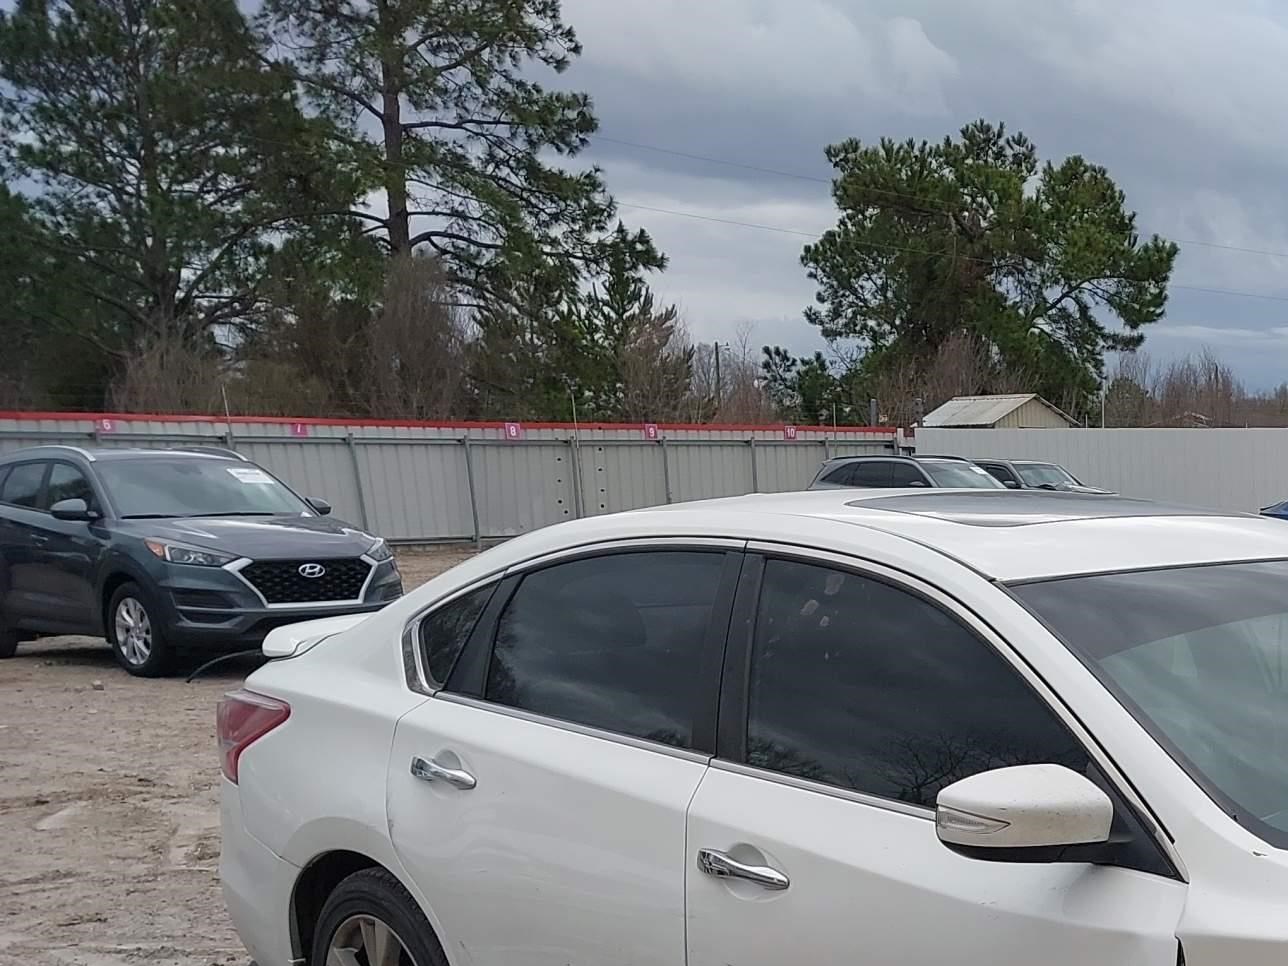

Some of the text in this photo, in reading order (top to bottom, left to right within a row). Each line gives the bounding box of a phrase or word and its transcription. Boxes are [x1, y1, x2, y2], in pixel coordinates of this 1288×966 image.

[509, 425, 517, 436] 8
[648, 426, 656, 438] 9
[786, 427, 795, 438] 10
